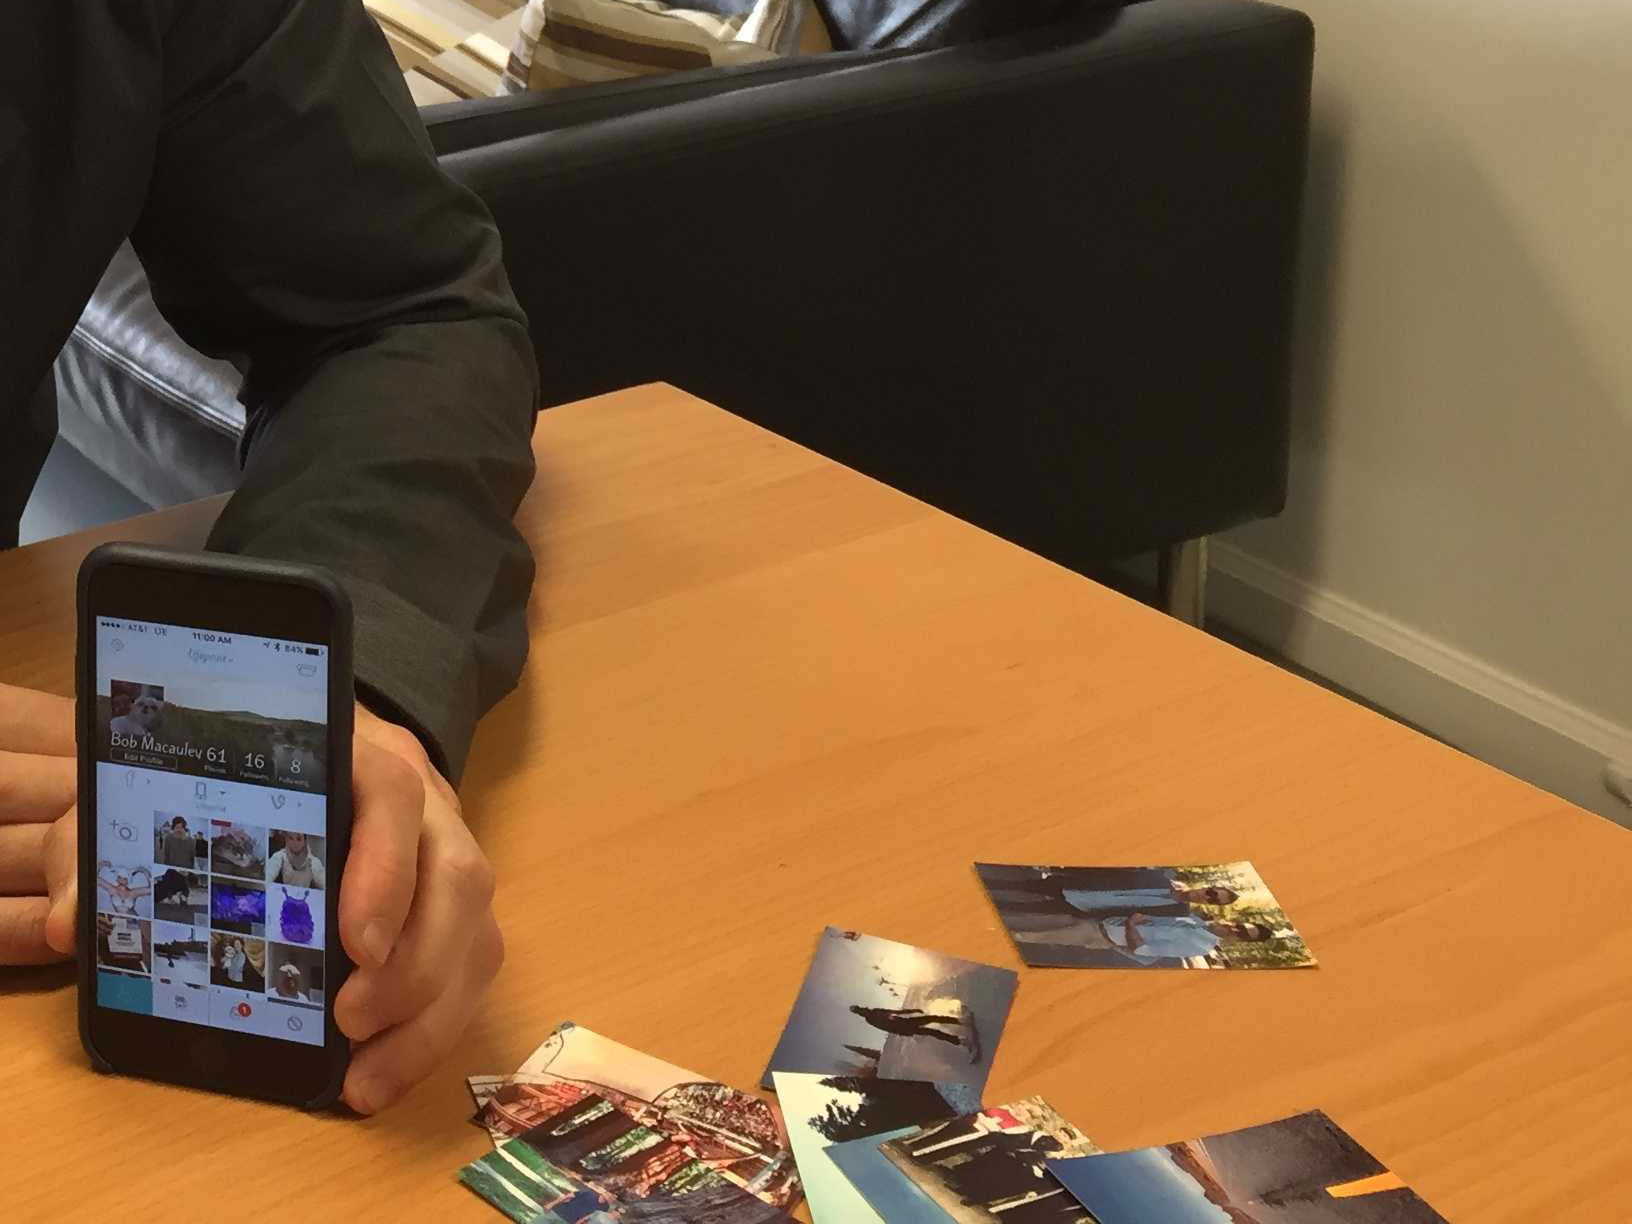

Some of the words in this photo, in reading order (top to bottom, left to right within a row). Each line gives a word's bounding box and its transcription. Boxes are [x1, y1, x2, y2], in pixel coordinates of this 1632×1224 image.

[191, 631, 216, 643] 11:00
[217, 635, 232, 645] AM
[111, 731, 137, 749] Bob
[206, 746, 227, 764] 61
[244, 752, 265, 769] 16
[289, 759, 302, 774] 8
